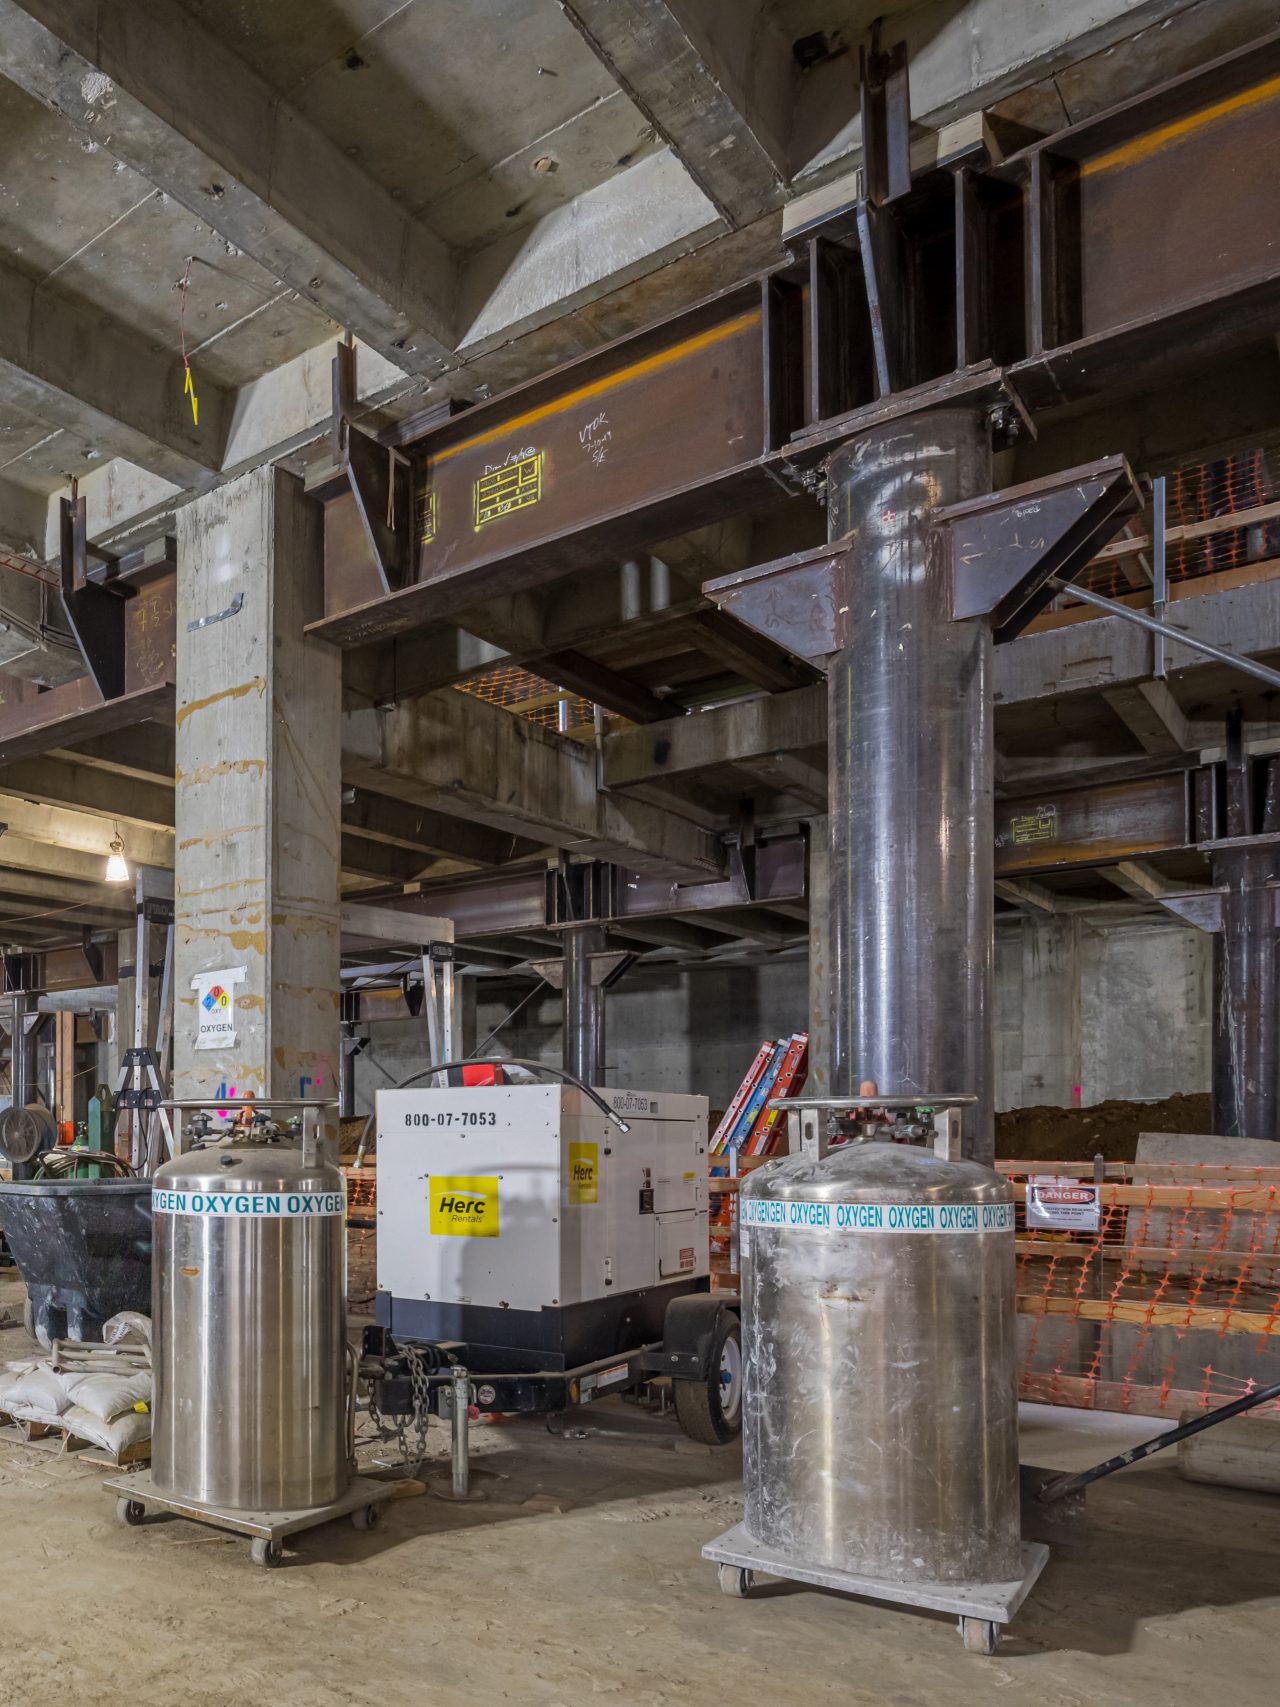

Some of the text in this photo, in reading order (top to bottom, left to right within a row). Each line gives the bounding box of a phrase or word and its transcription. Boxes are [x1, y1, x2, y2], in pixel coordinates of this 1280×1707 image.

[214, 986, 220, 997] 0
[206, 996, 212, 1008] 2
[221, 995, 228, 1007] 0
[200, 1023, 233, 1033] OXYGEN
[405, 1112, 497, 1127] 800-07-7053
[573, 1164, 593, 1181] Herc
[1038, 1191, 1089, 1200] DANGER
[192, 1194, 280, 1214] OXYGEN
[439, 1197, 486, 1214] Herc
[451, 1214, 483, 1224] Rentals
[790, 1202, 830, 1225] OXYGEN
[836, 1205, 883, 1228] OXYGEN
[888, 1205, 934, 1229] OXYGEN
[939, 1206, 978, 1229] OXYGEN
